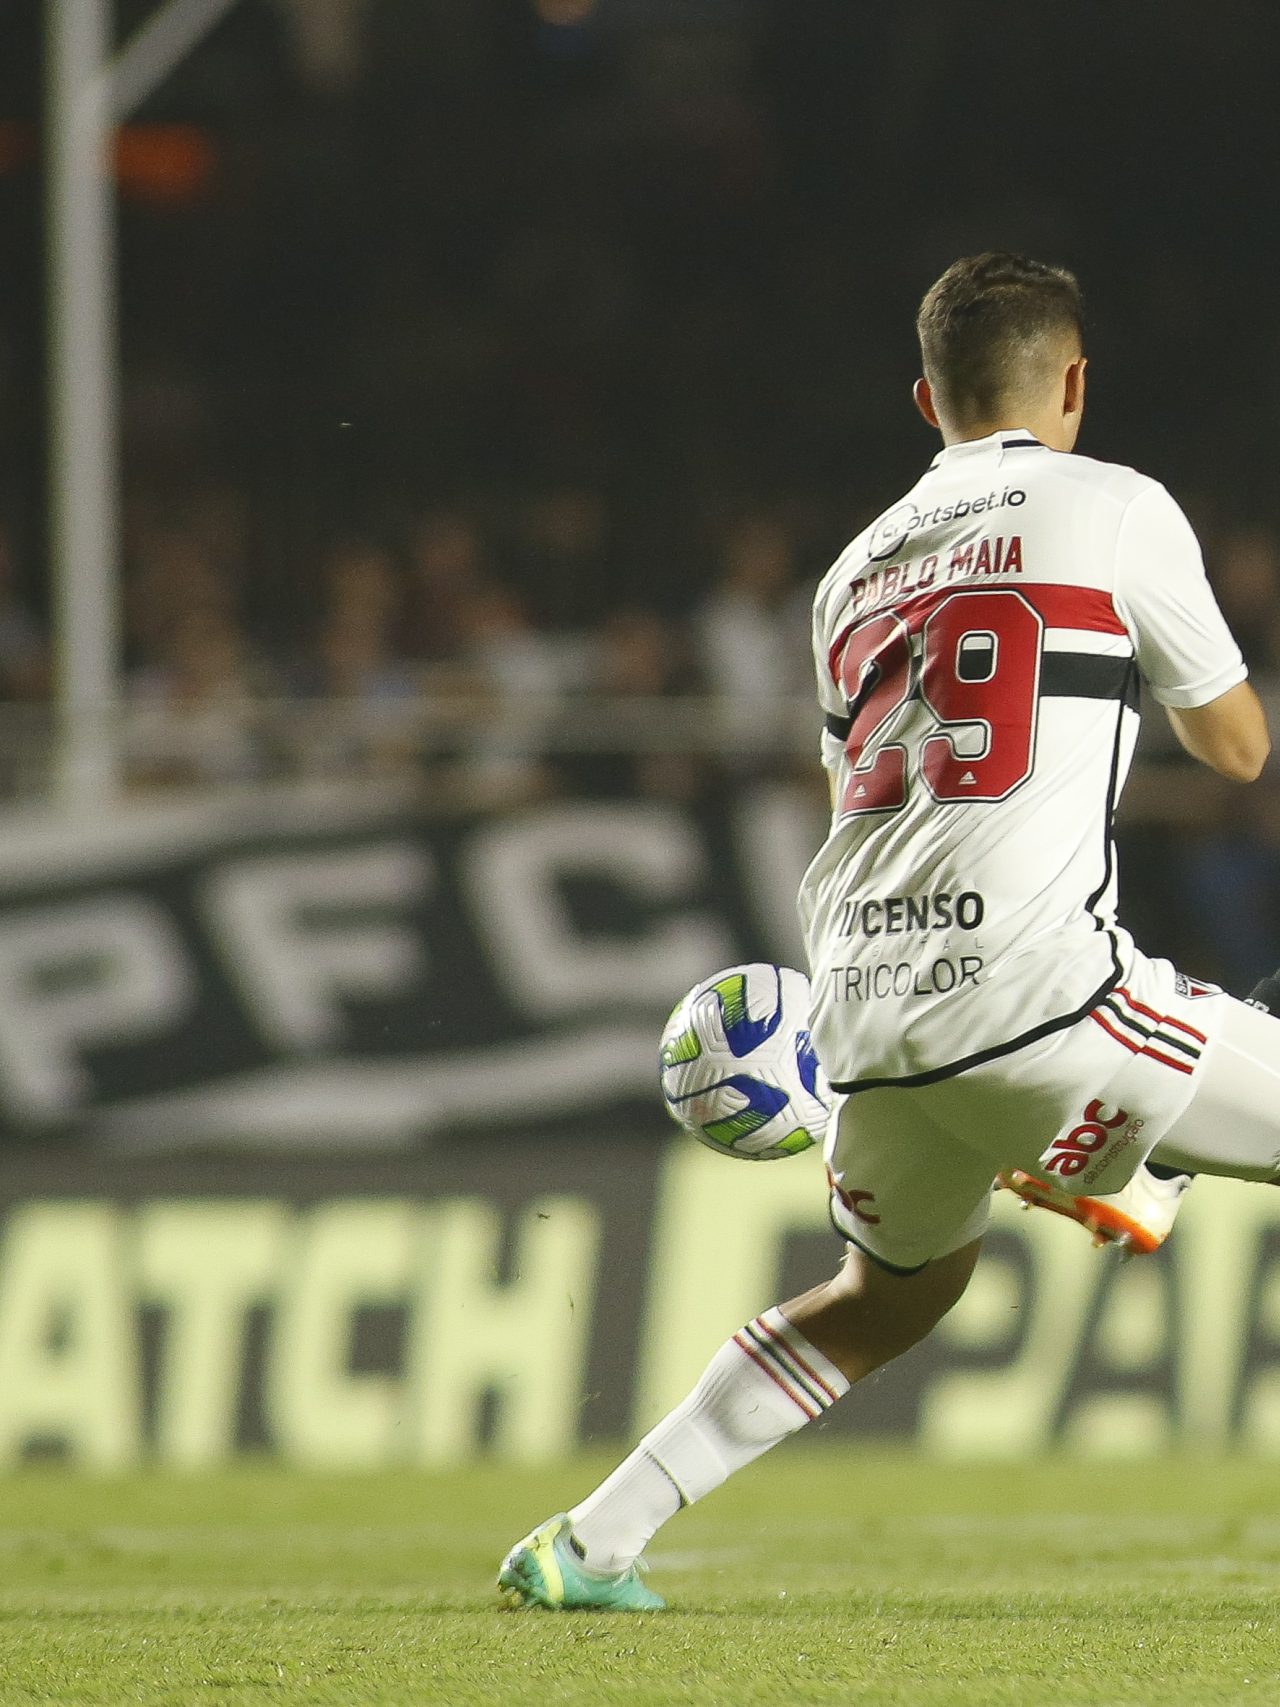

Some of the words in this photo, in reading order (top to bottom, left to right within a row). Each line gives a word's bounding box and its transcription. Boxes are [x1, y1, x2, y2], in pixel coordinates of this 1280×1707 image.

[849, 554, 939, 609] PABLO
[947, 535, 1023, 582] MAIA
[835, 589, 1045, 815] 29
[830, 955, 984, 1002] TRICOLOR
[1044, 1097, 1129, 1177] abc
[0, 1200, 602, 1472] ATCH
